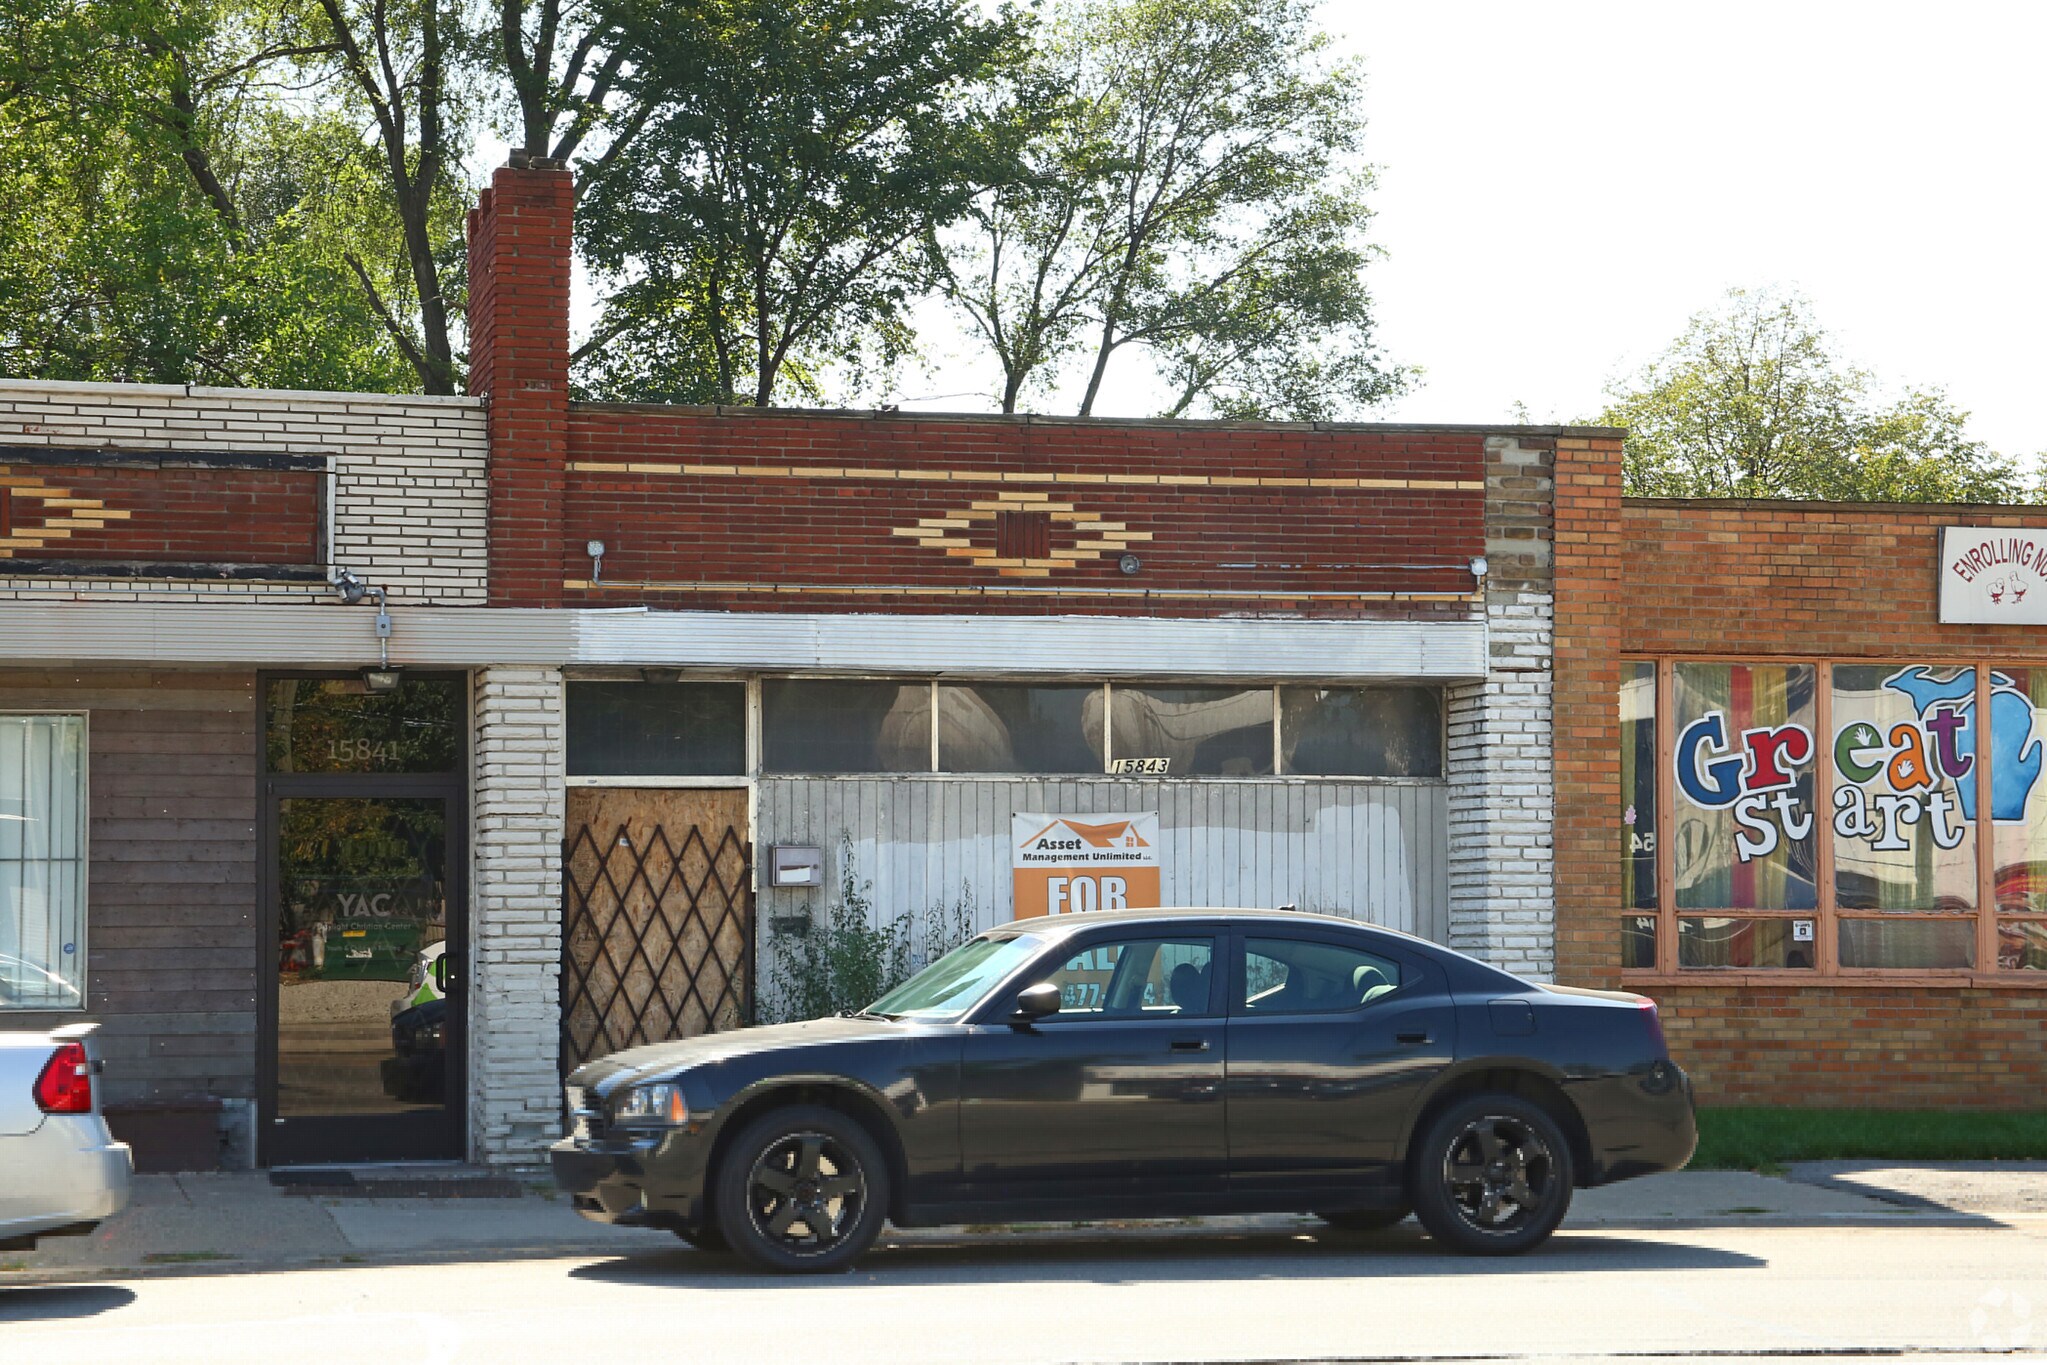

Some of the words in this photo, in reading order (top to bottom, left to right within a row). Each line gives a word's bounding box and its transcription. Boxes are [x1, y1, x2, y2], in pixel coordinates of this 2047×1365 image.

[1952, 538, 2034, 583] ENROLLING
[327, 738, 400, 765] 15841
[1675, 706, 1973, 807] Great
[1115, 759, 1168, 774] 15843
[1036, 838, 1082, 850] Asset
[1022, 852, 1089, 863] Management
[1092, 852, 1142, 861] Unlimited
[337, 893, 391, 917] YAC
[1047, 875, 1128, 916] FOR
[386, 922, 411, 930] Center
